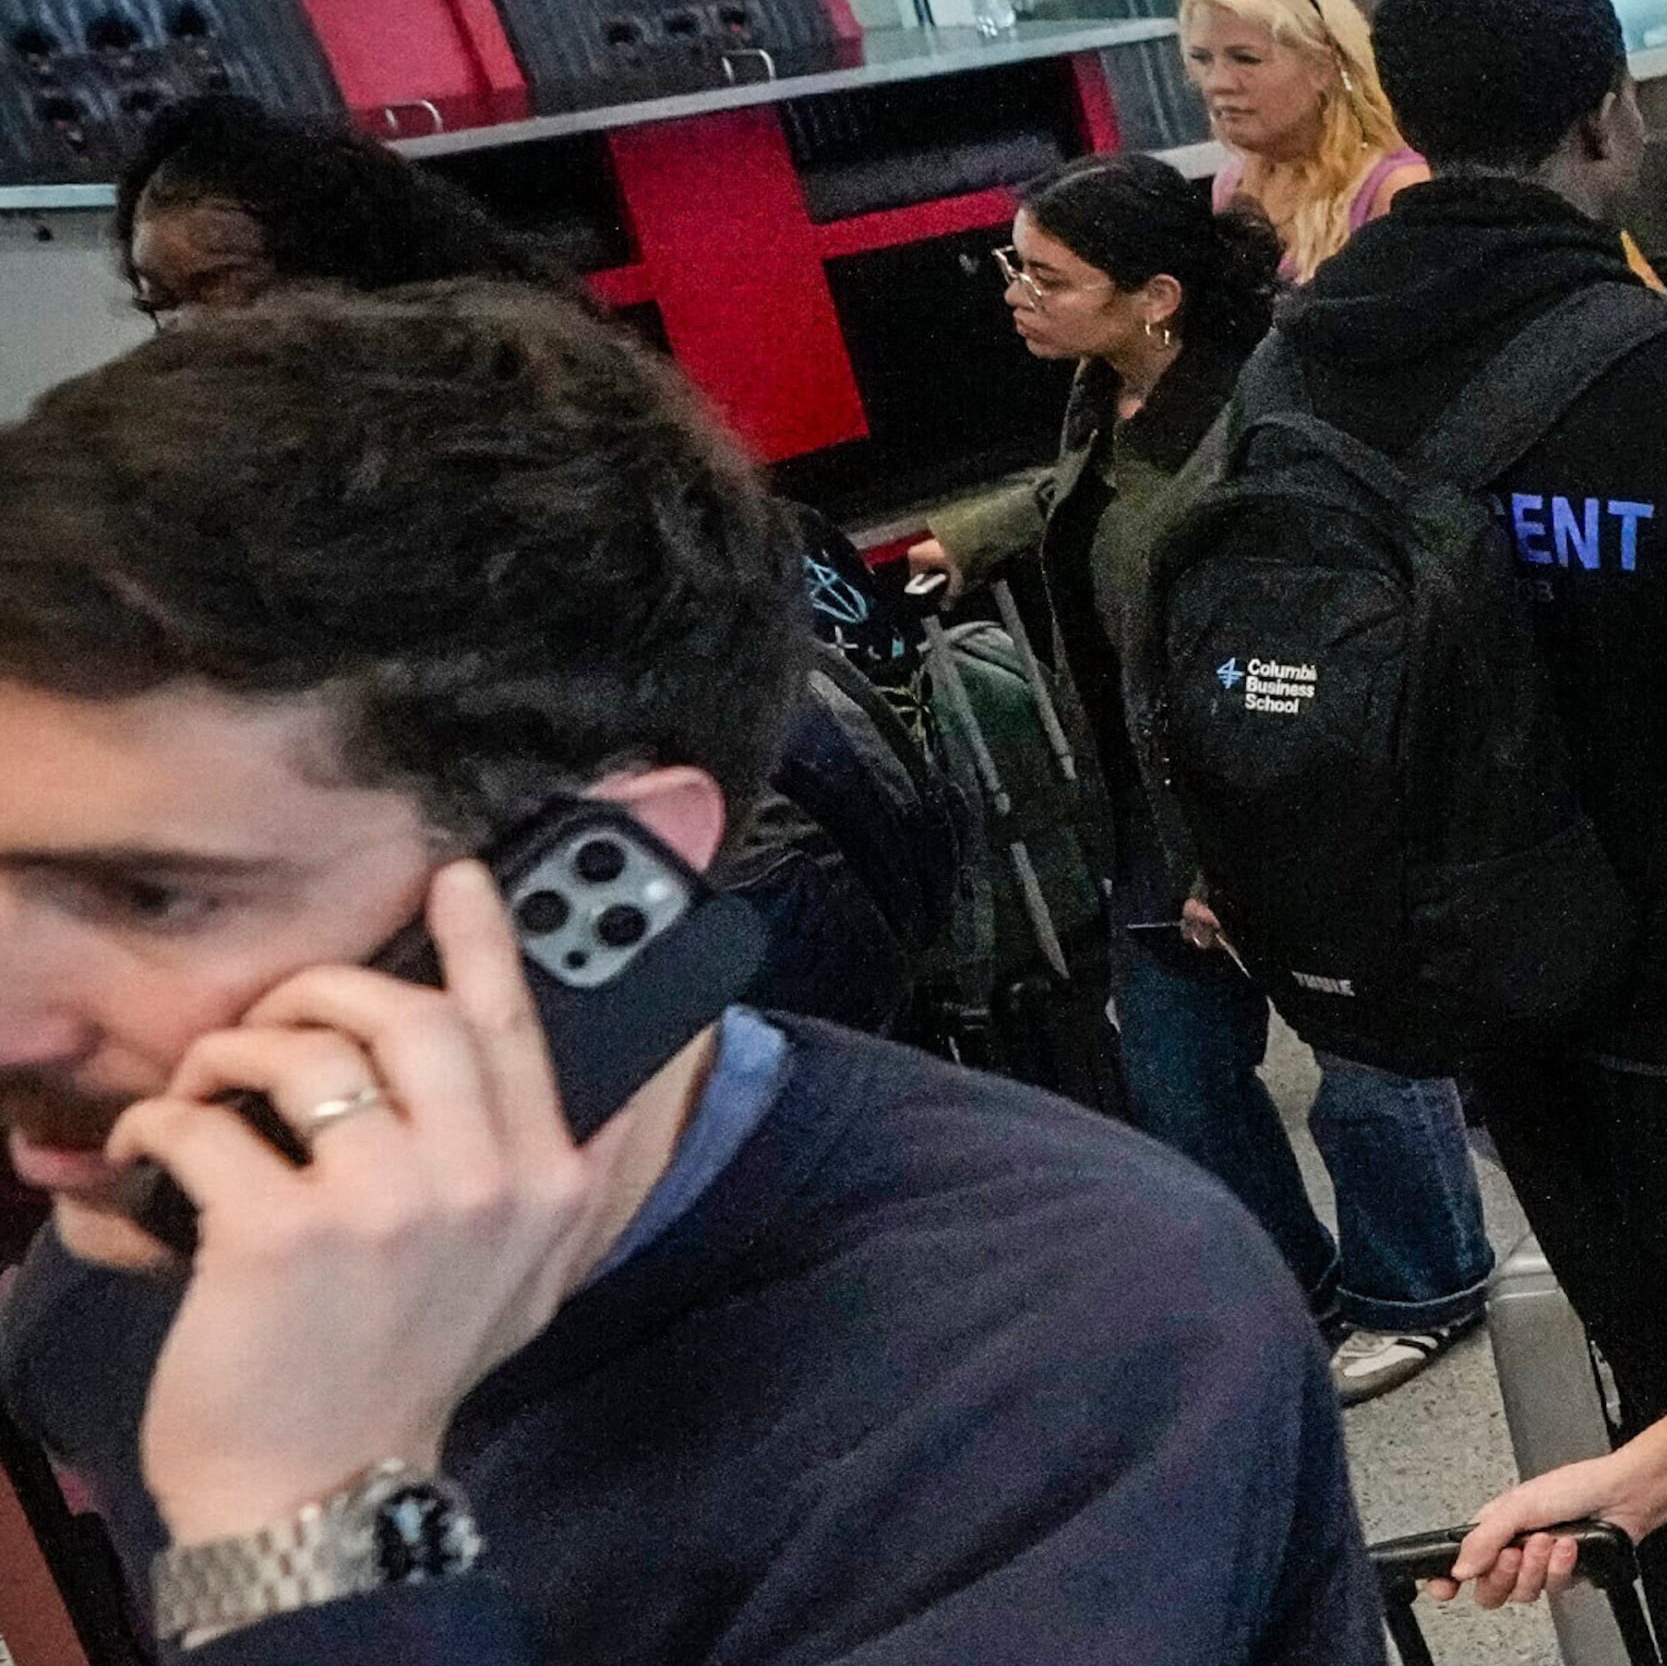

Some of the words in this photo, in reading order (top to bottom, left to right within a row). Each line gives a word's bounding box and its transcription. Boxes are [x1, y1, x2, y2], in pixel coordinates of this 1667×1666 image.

[1510, 492, 1655, 572] ENT
[1247, 658, 1318, 682] Columbi
[1245, 675, 1316, 698] Business
[1244, 693, 1300, 714] School
